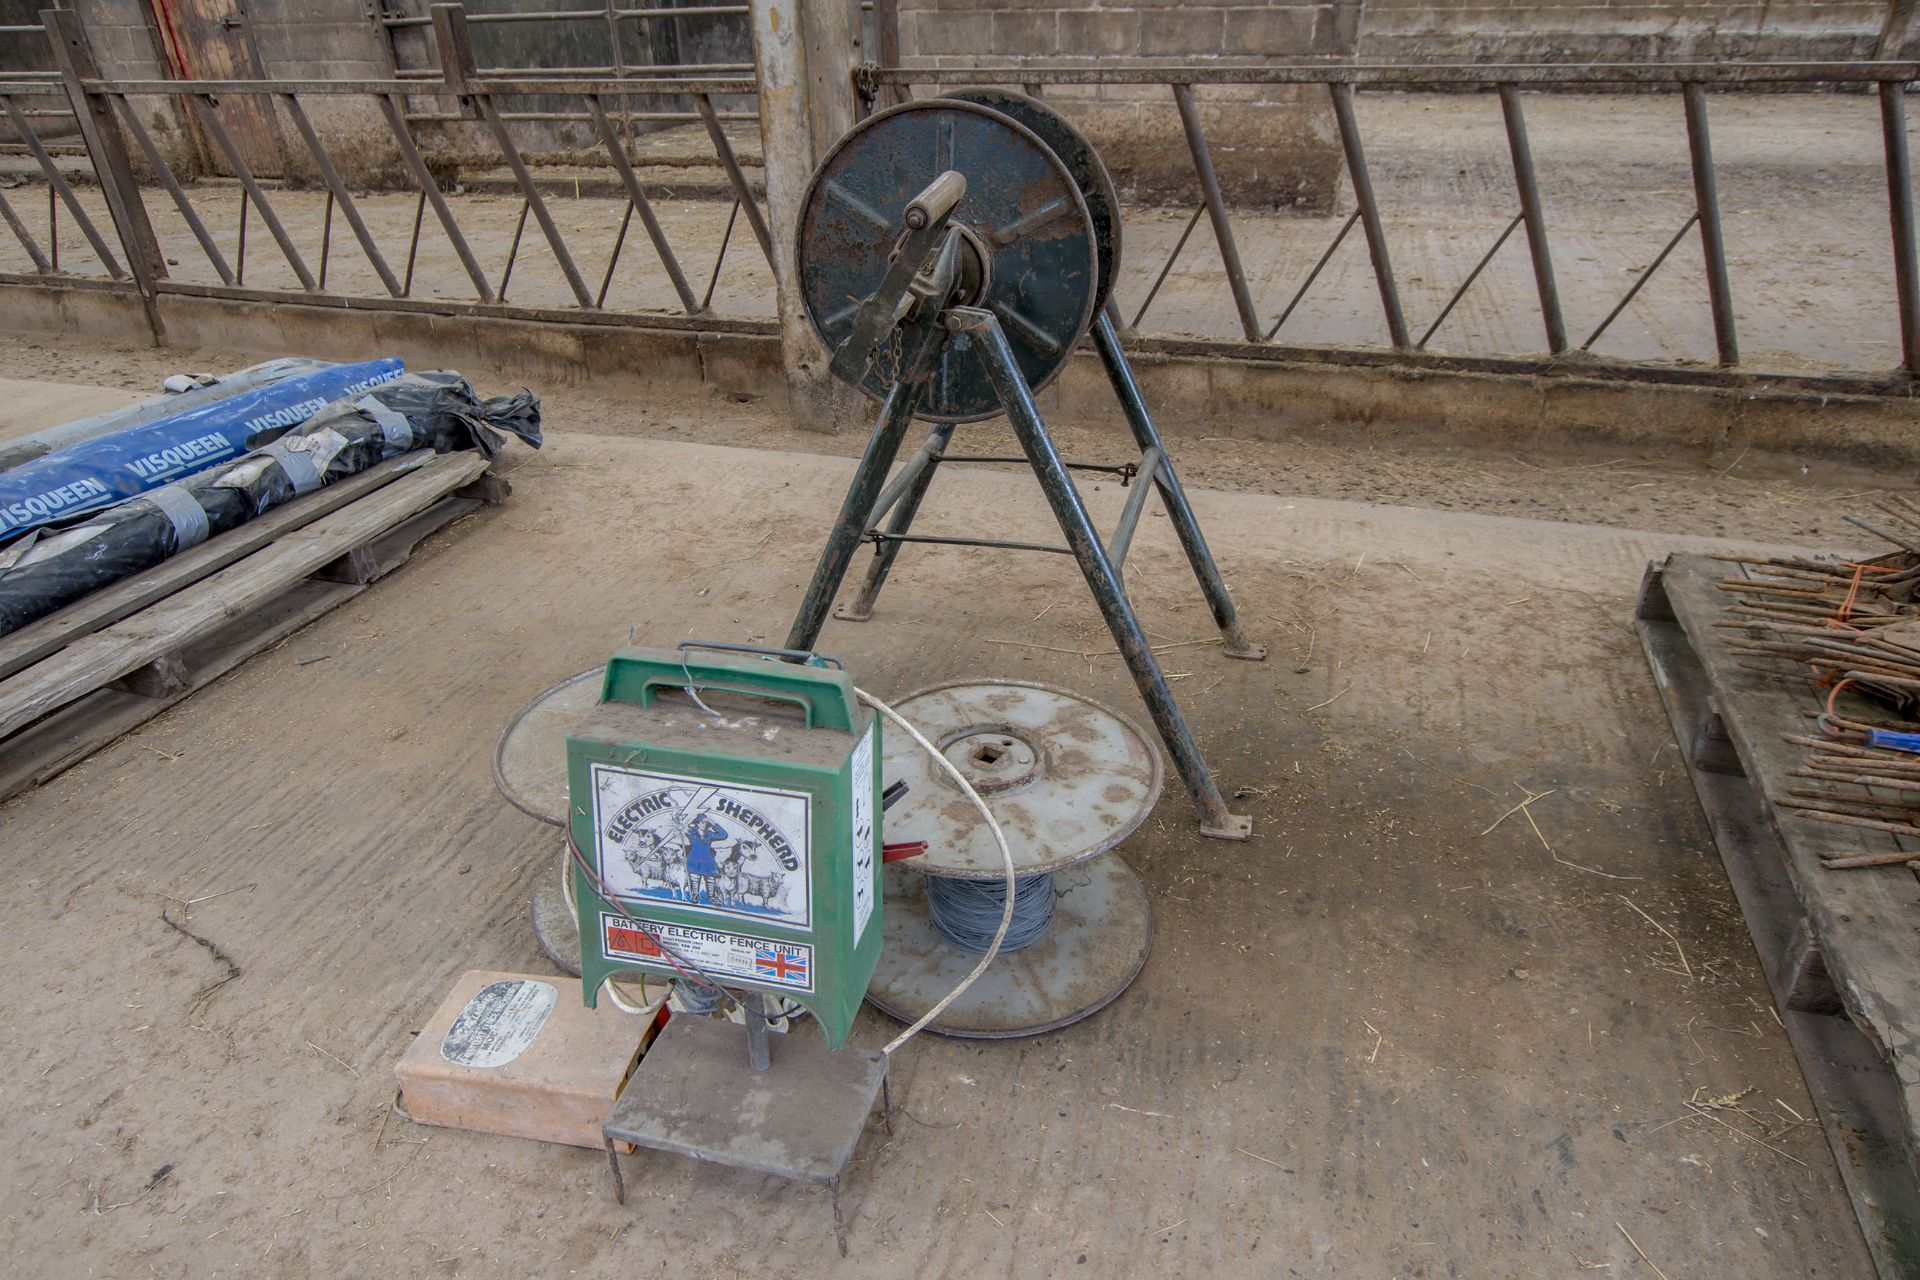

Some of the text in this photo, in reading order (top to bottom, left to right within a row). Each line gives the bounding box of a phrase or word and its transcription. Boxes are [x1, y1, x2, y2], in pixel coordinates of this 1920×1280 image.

[125, 431, 231, 478] VISQUEEN
[608, 792, 799, 872] ELECTRIC SHEPHERD
[668, 926, 726, 944] ELECTRIC
[729, 936, 770, 951] FENCE
[773, 944, 802, 956] UNIT
